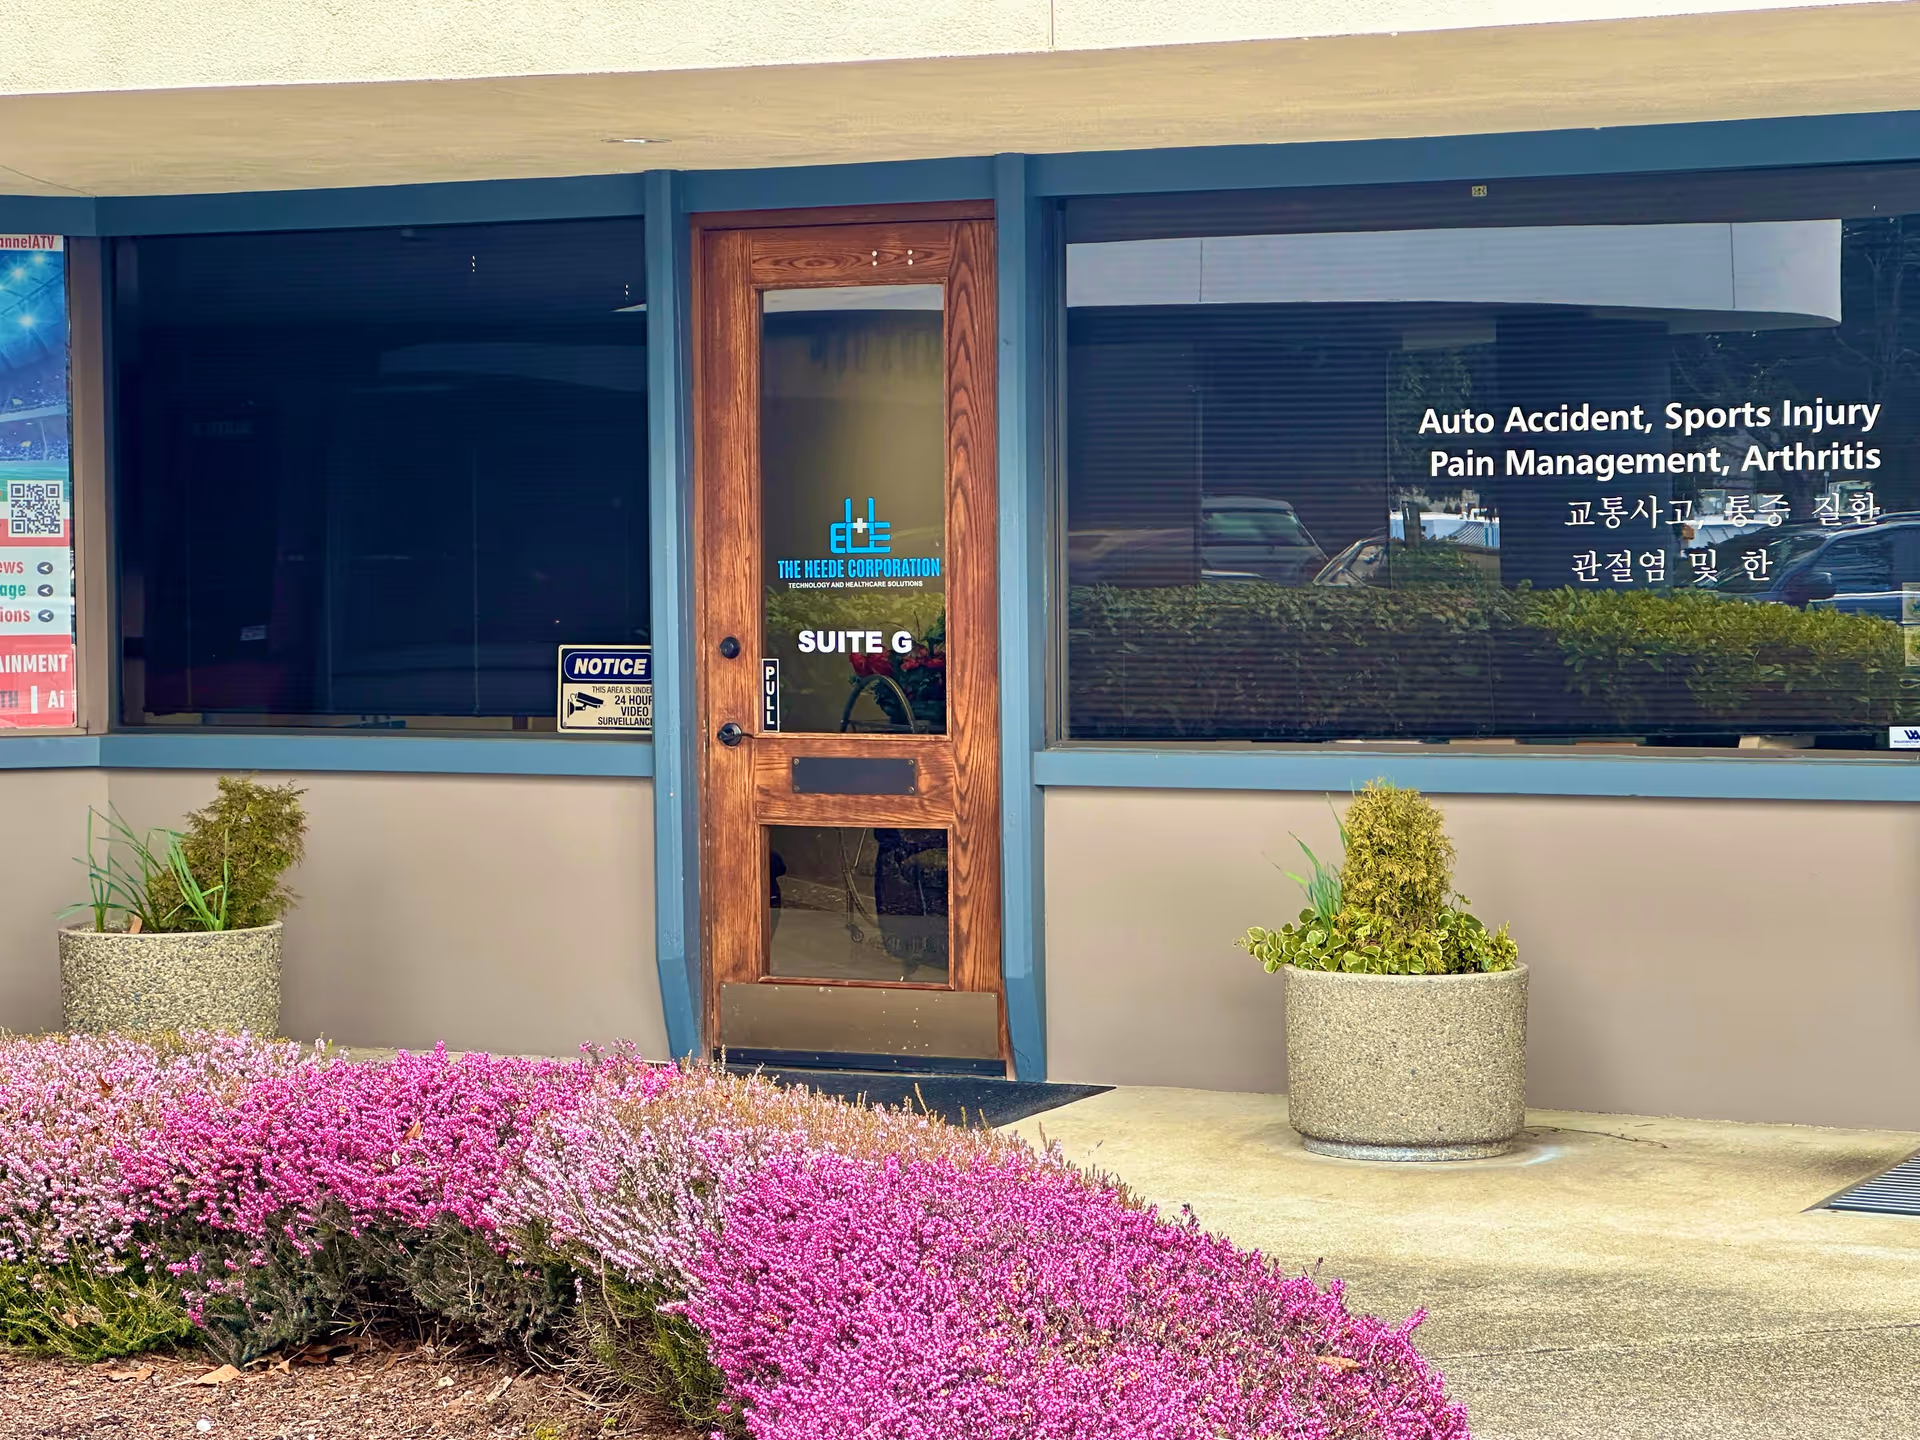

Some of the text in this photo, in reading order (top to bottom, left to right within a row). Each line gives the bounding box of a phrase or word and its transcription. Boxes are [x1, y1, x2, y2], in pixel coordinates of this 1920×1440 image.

[1418, 397, 1882, 436] Auto Accident, Sports Injury
[1430, 441, 1882, 482] Pain Management, Arthritis
[1564, 491, 1882, 530] 교통사고, 통증 질환
[777, 558, 941, 578] THE HEEDE CORPORATION
[1571, 548, 1774, 583] 관절염 및 한
[887, 580, 923, 588] SOLUTIONS
[798, 630, 913, 653] SUITE G
[574, 657, 648, 675] NOTICE
[48, 690, 65, 708] Ai
[592, 686, 652, 694] THIS AREA IS UNDE
[765, 666, 775, 725] PULL
[614, 695, 626, 706] 24
[597, 716, 652, 726] SURVEILLANC
[620, 706, 649, 717] VIDEO
